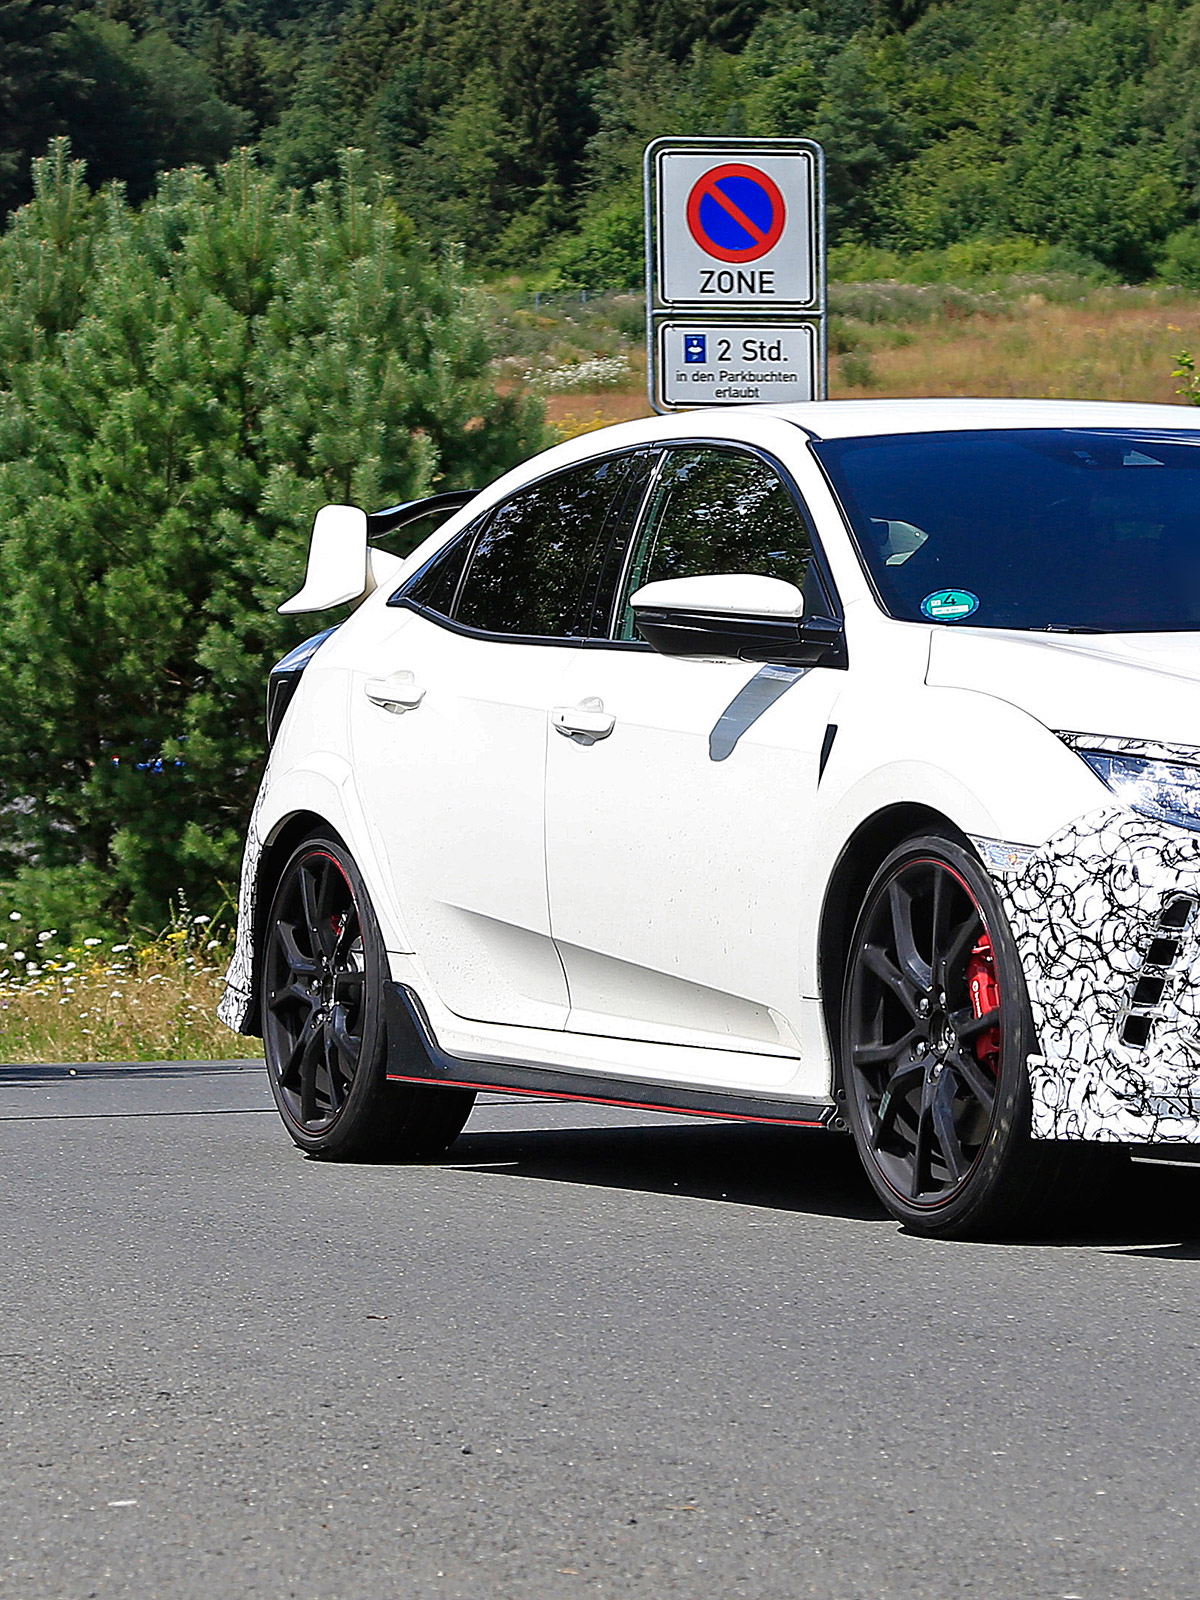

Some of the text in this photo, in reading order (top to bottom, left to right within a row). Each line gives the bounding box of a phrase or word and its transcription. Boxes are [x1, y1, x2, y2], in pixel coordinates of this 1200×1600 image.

[700, 270, 775, 294] ZONE
[717, 339, 788, 361] 2 Std.
[676, 370, 798, 382] in den Parkbuchten
[715, 386, 760, 398] erlaubt
[943, 594, 957, 605] 4
